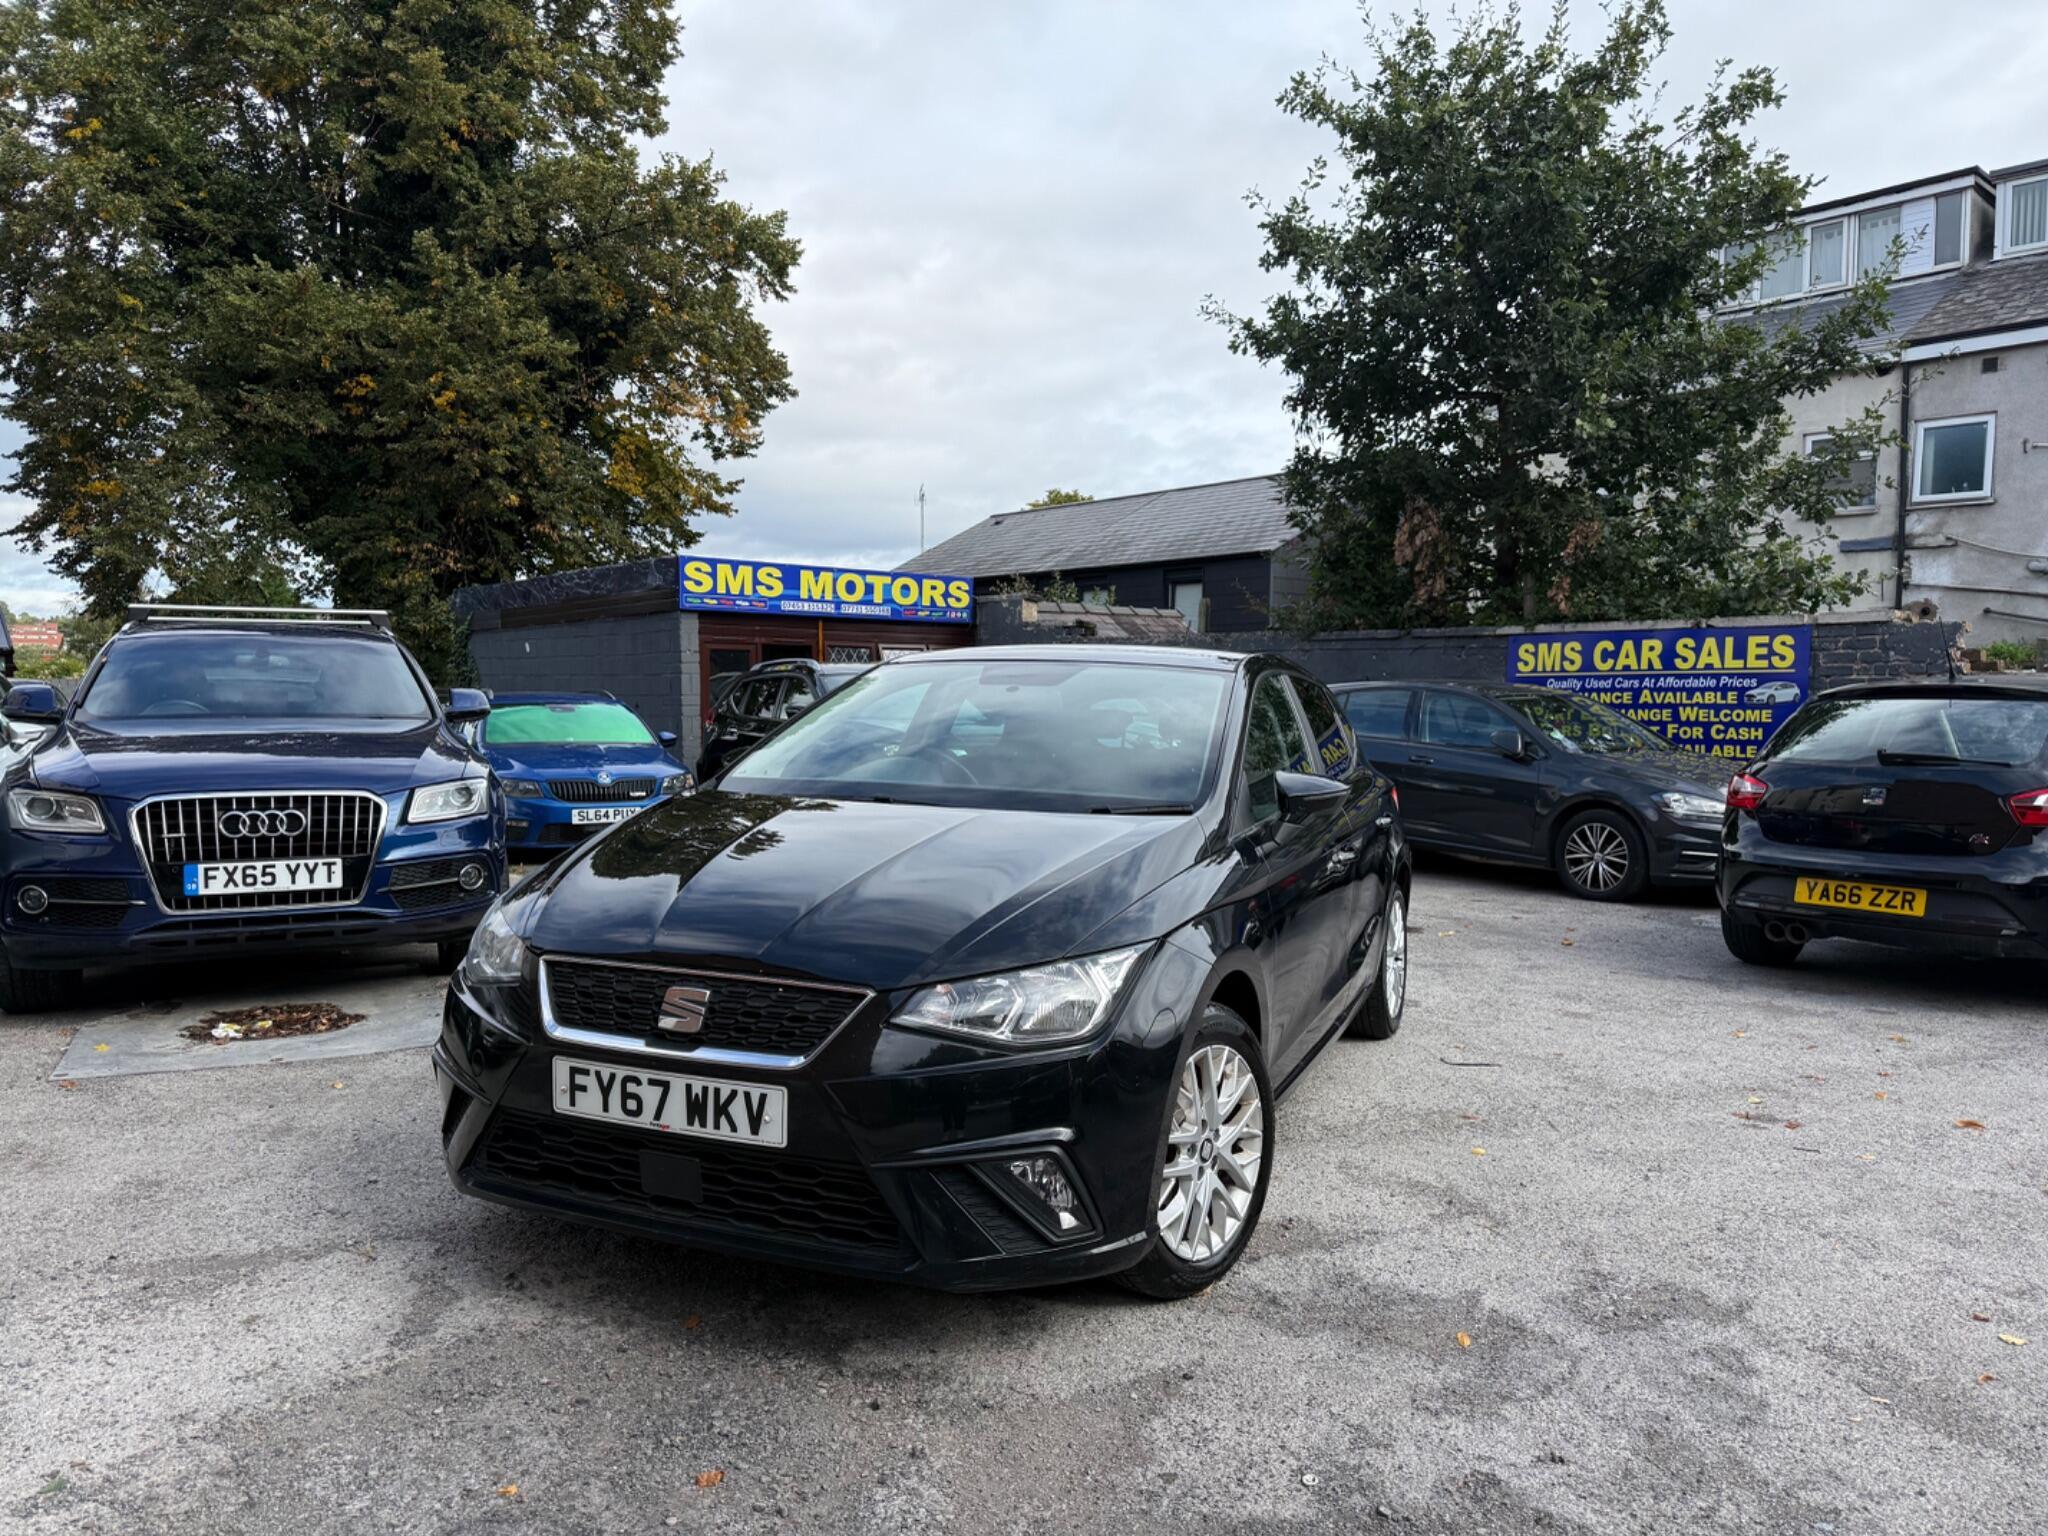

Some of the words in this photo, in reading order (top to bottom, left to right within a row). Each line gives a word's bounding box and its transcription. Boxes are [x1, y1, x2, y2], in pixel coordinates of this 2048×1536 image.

[683, 561, 784, 598] SMS
[800, 569, 971, 608] MOTORS
[1516, 641, 1583, 672] SMS
[1593, 638, 1663, 670] CAR
[1674, 634, 1795, 670] SALES
[1547, 677, 1582, 691] Quality
[1585, 677, 1613, 689] Used
[1615, 677, 1640, 688] Cars
[1641, 676, 1657, 688] At
[1657, 675, 1716, 688] Affordable
[1719, 676, 1758, 688] Prices
[1582, 690, 1633, 704] ANCE
[1639, 689, 1738, 704] AVAILABLE
[1679, 706, 1773, 722] WELCOME
[1667, 723, 1704, 739] FOR
[1711, 724, 1763, 740] CASH
[1680, 744, 1758, 759] AILABLE
[577, 810, 610, 821] SL64
[203, 864, 277, 889] FX65
[285, 862, 338, 885] YYT
[1806, 881, 1862, 905] YA66
[1868, 887, 1917, 911] ZZR
[568, 1065, 670, 1122] FY67
[685, 1083, 768, 1136] WKV
